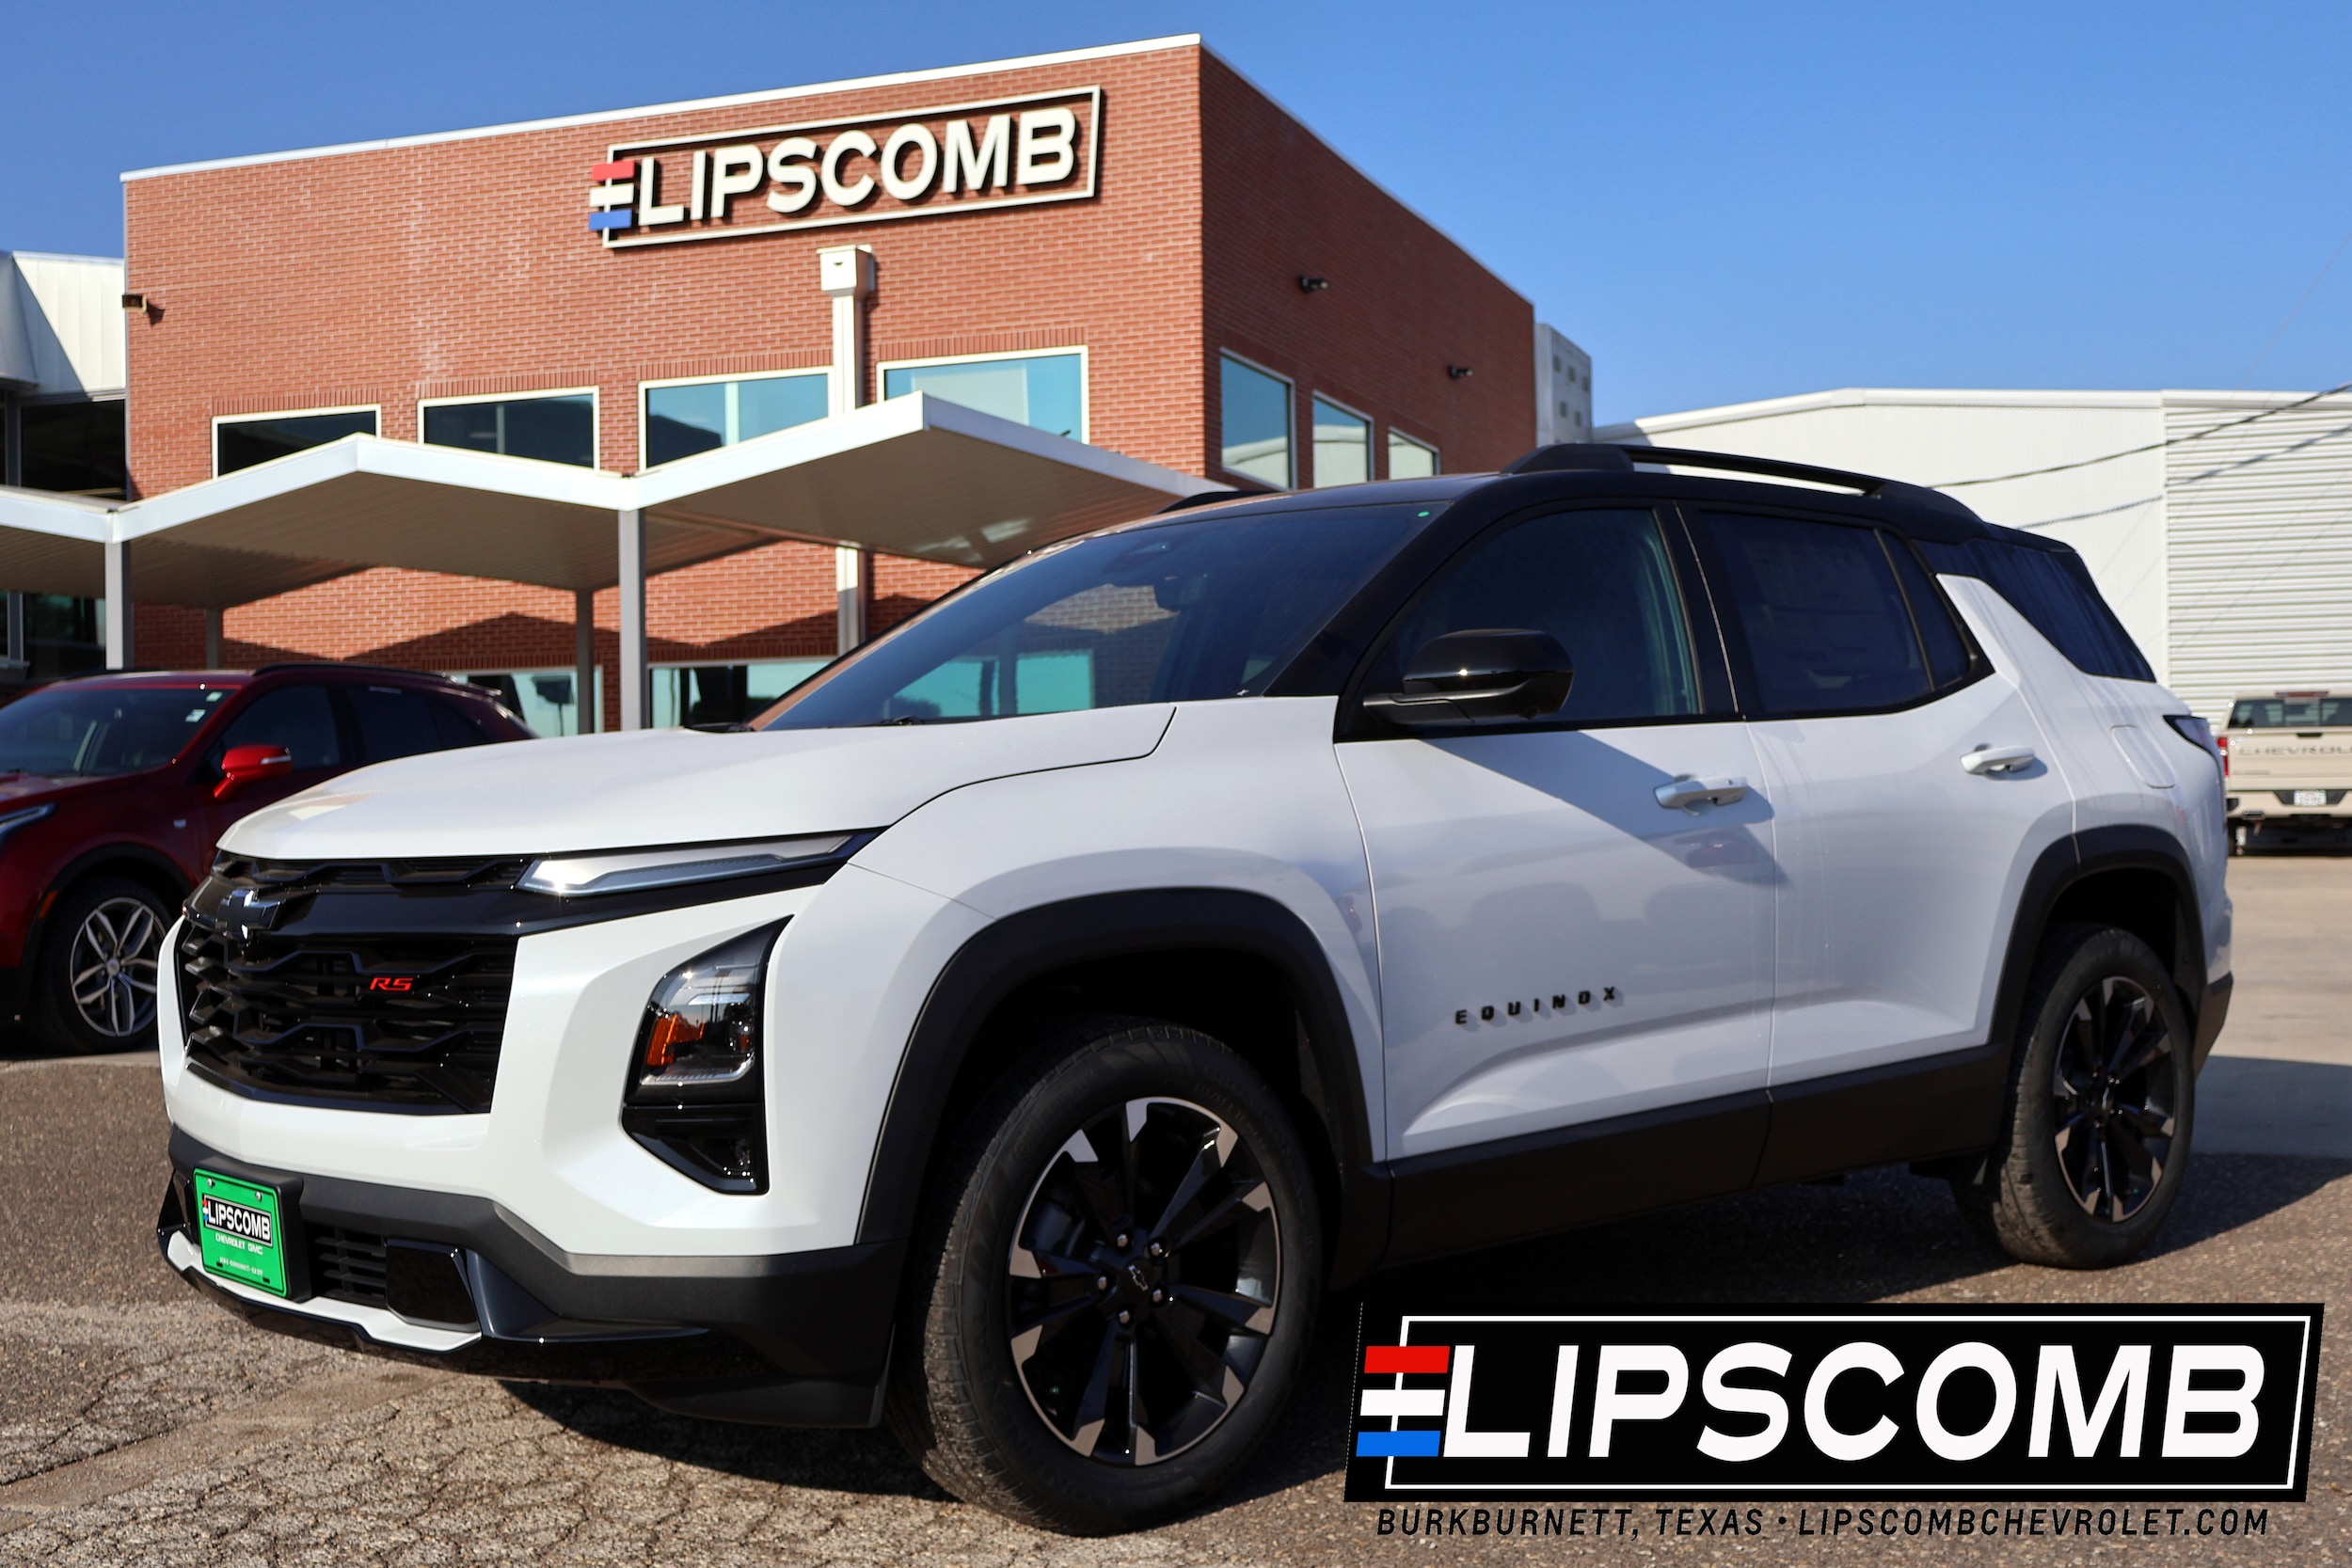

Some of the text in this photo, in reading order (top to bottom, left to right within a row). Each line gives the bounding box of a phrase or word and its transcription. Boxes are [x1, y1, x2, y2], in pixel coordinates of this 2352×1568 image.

[638, 107, 1077, 226] LIPSCOMB
[2238, 744, 2352, 755] CHEVROL
[370, 977, 414, 991] RS
[1454, 986, 1615, 1025] EQUINOX
[208, 1200, 271, 1241] LIPSCOMB
[215, 1232, 263, 1256] CHEVROLET GMC
